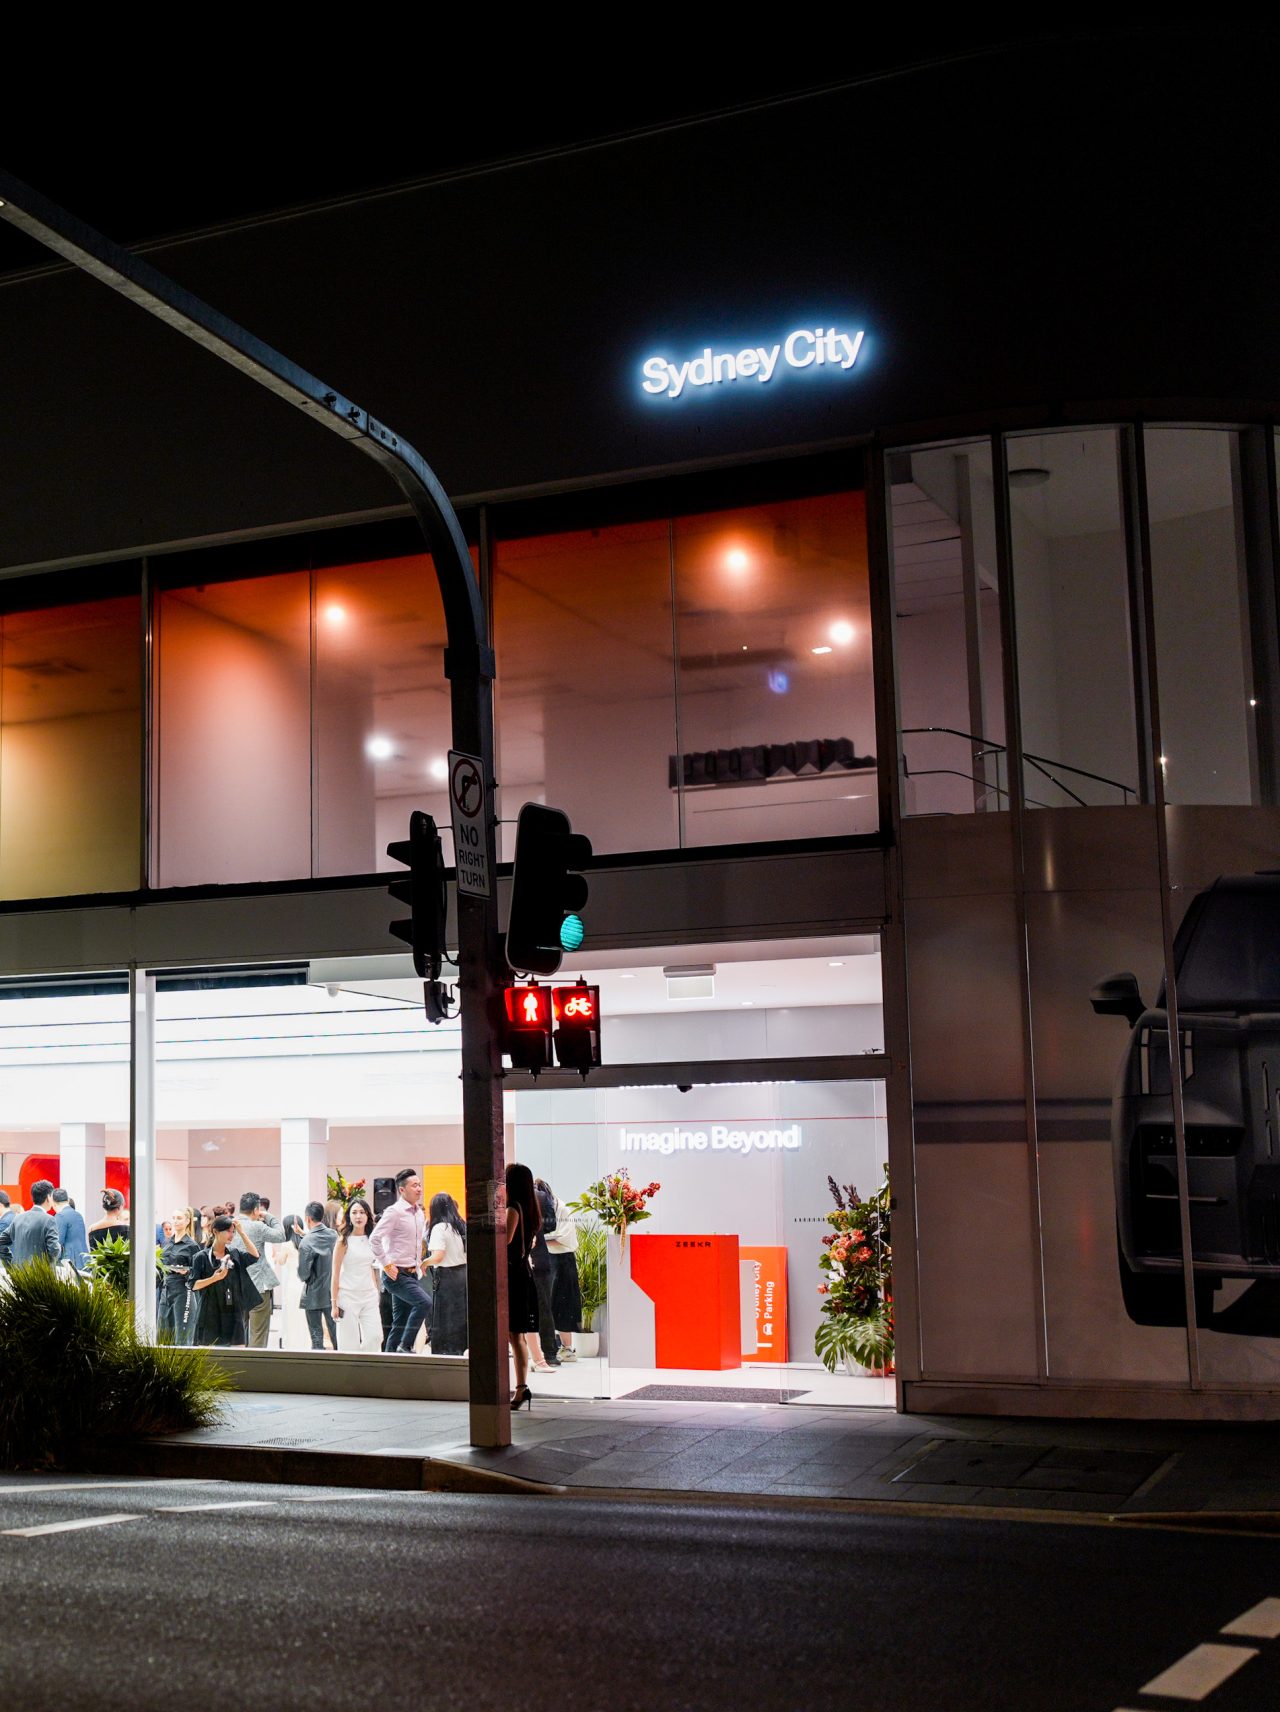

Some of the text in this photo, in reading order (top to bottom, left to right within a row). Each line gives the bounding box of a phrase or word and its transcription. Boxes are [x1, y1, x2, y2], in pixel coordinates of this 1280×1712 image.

[642, 327, 865, 398] Sydney City
[459, 823, 479, 847] NO
[458, 849, 485, 868] RIGHT
[460, 869, 486, 889] TURN
[620, 1124, 802, 1155] Imagine Beyond
[763, 1281, 775, 1319] Parking
